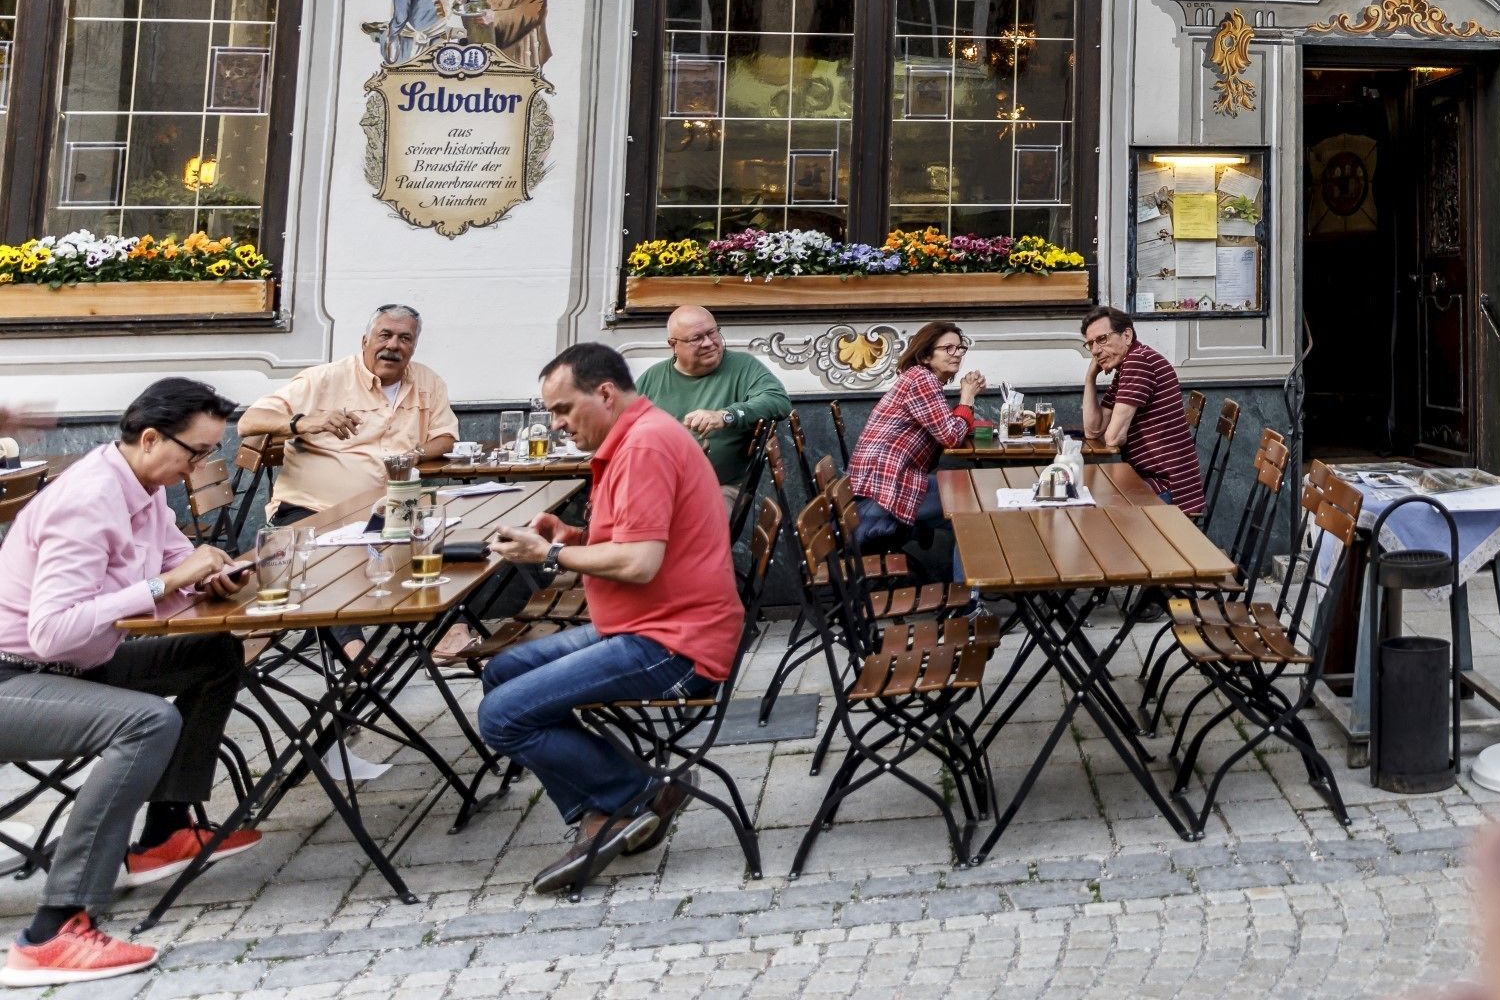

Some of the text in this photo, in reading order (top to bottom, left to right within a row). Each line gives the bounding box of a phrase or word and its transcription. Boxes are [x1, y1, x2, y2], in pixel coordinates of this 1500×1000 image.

[398, 81, 523, 113] Salvator
[448, 128, 473, 137] aus
[405, 141, 511, 155] seiner historischen
[413, 160, 502, 172] Braustätte der
[395, 174, 518, 189] Paulanerbrauerei in
[418, 195, 488, 208] München
